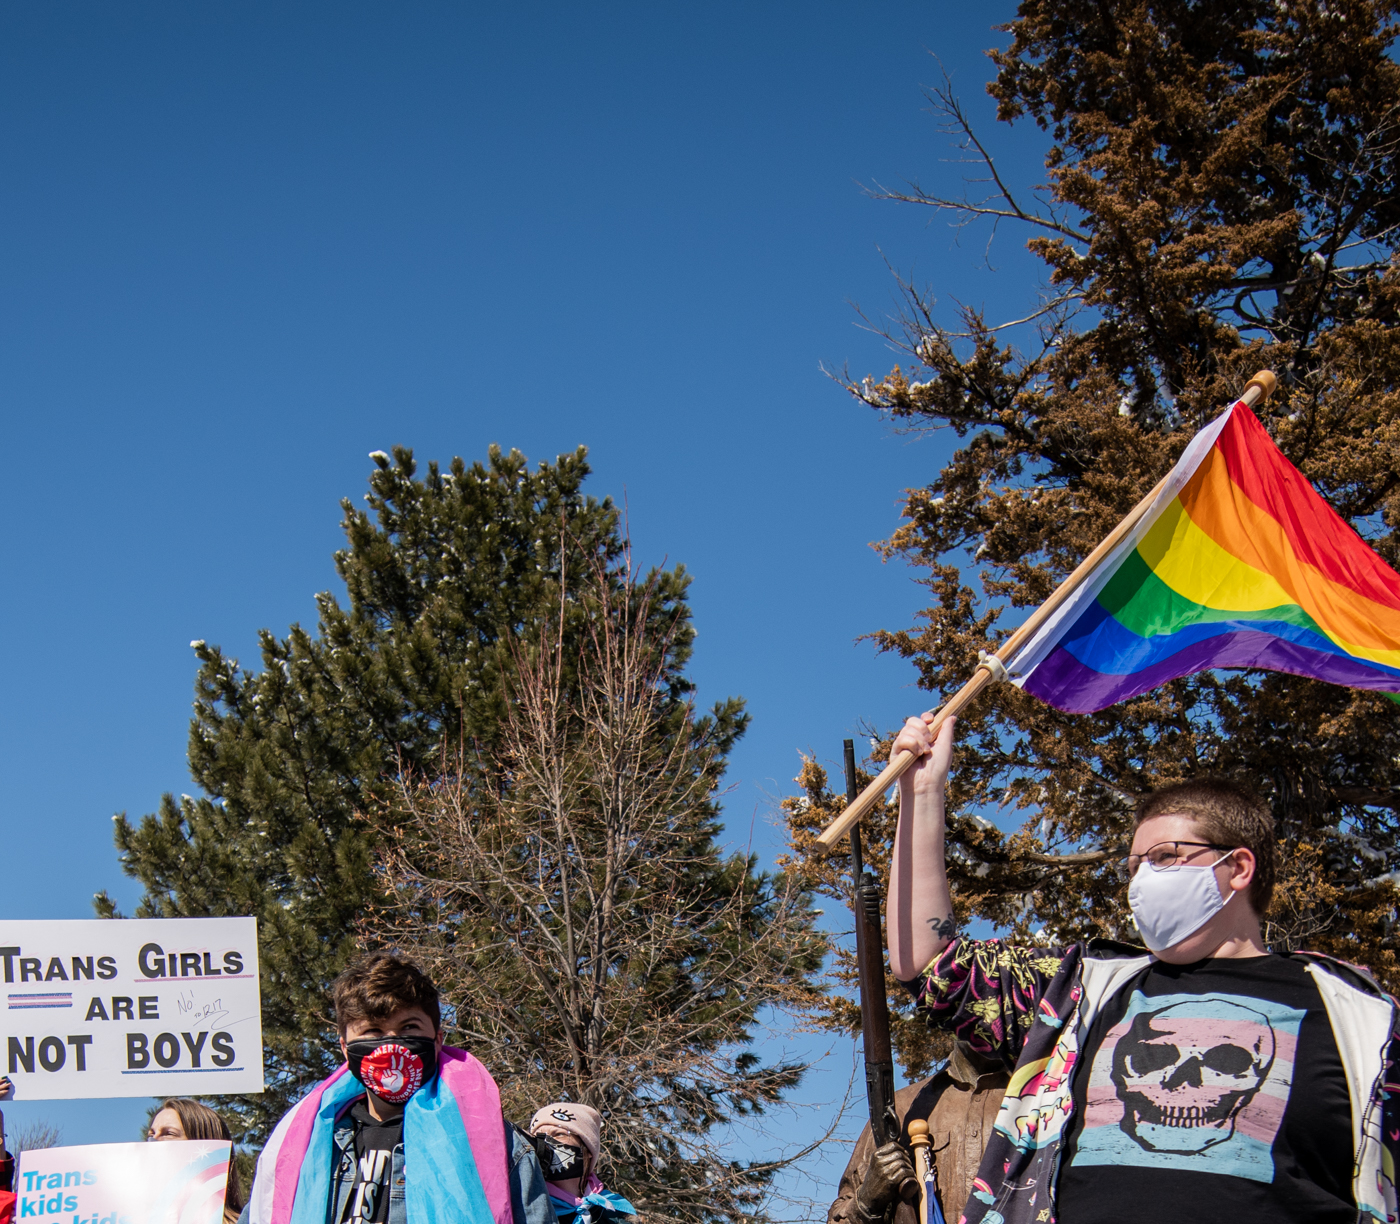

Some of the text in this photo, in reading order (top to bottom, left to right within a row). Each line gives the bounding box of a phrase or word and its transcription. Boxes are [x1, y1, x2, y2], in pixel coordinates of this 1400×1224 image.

[138, 943, 245, 979] GIRLS
[84, 996, 160, 1022] ARE
[8, 1031, 236, 1074] NOT BOYS
[22, 1169, 98, 1193] Trans
[20, 1193, 78, 1218] kids
